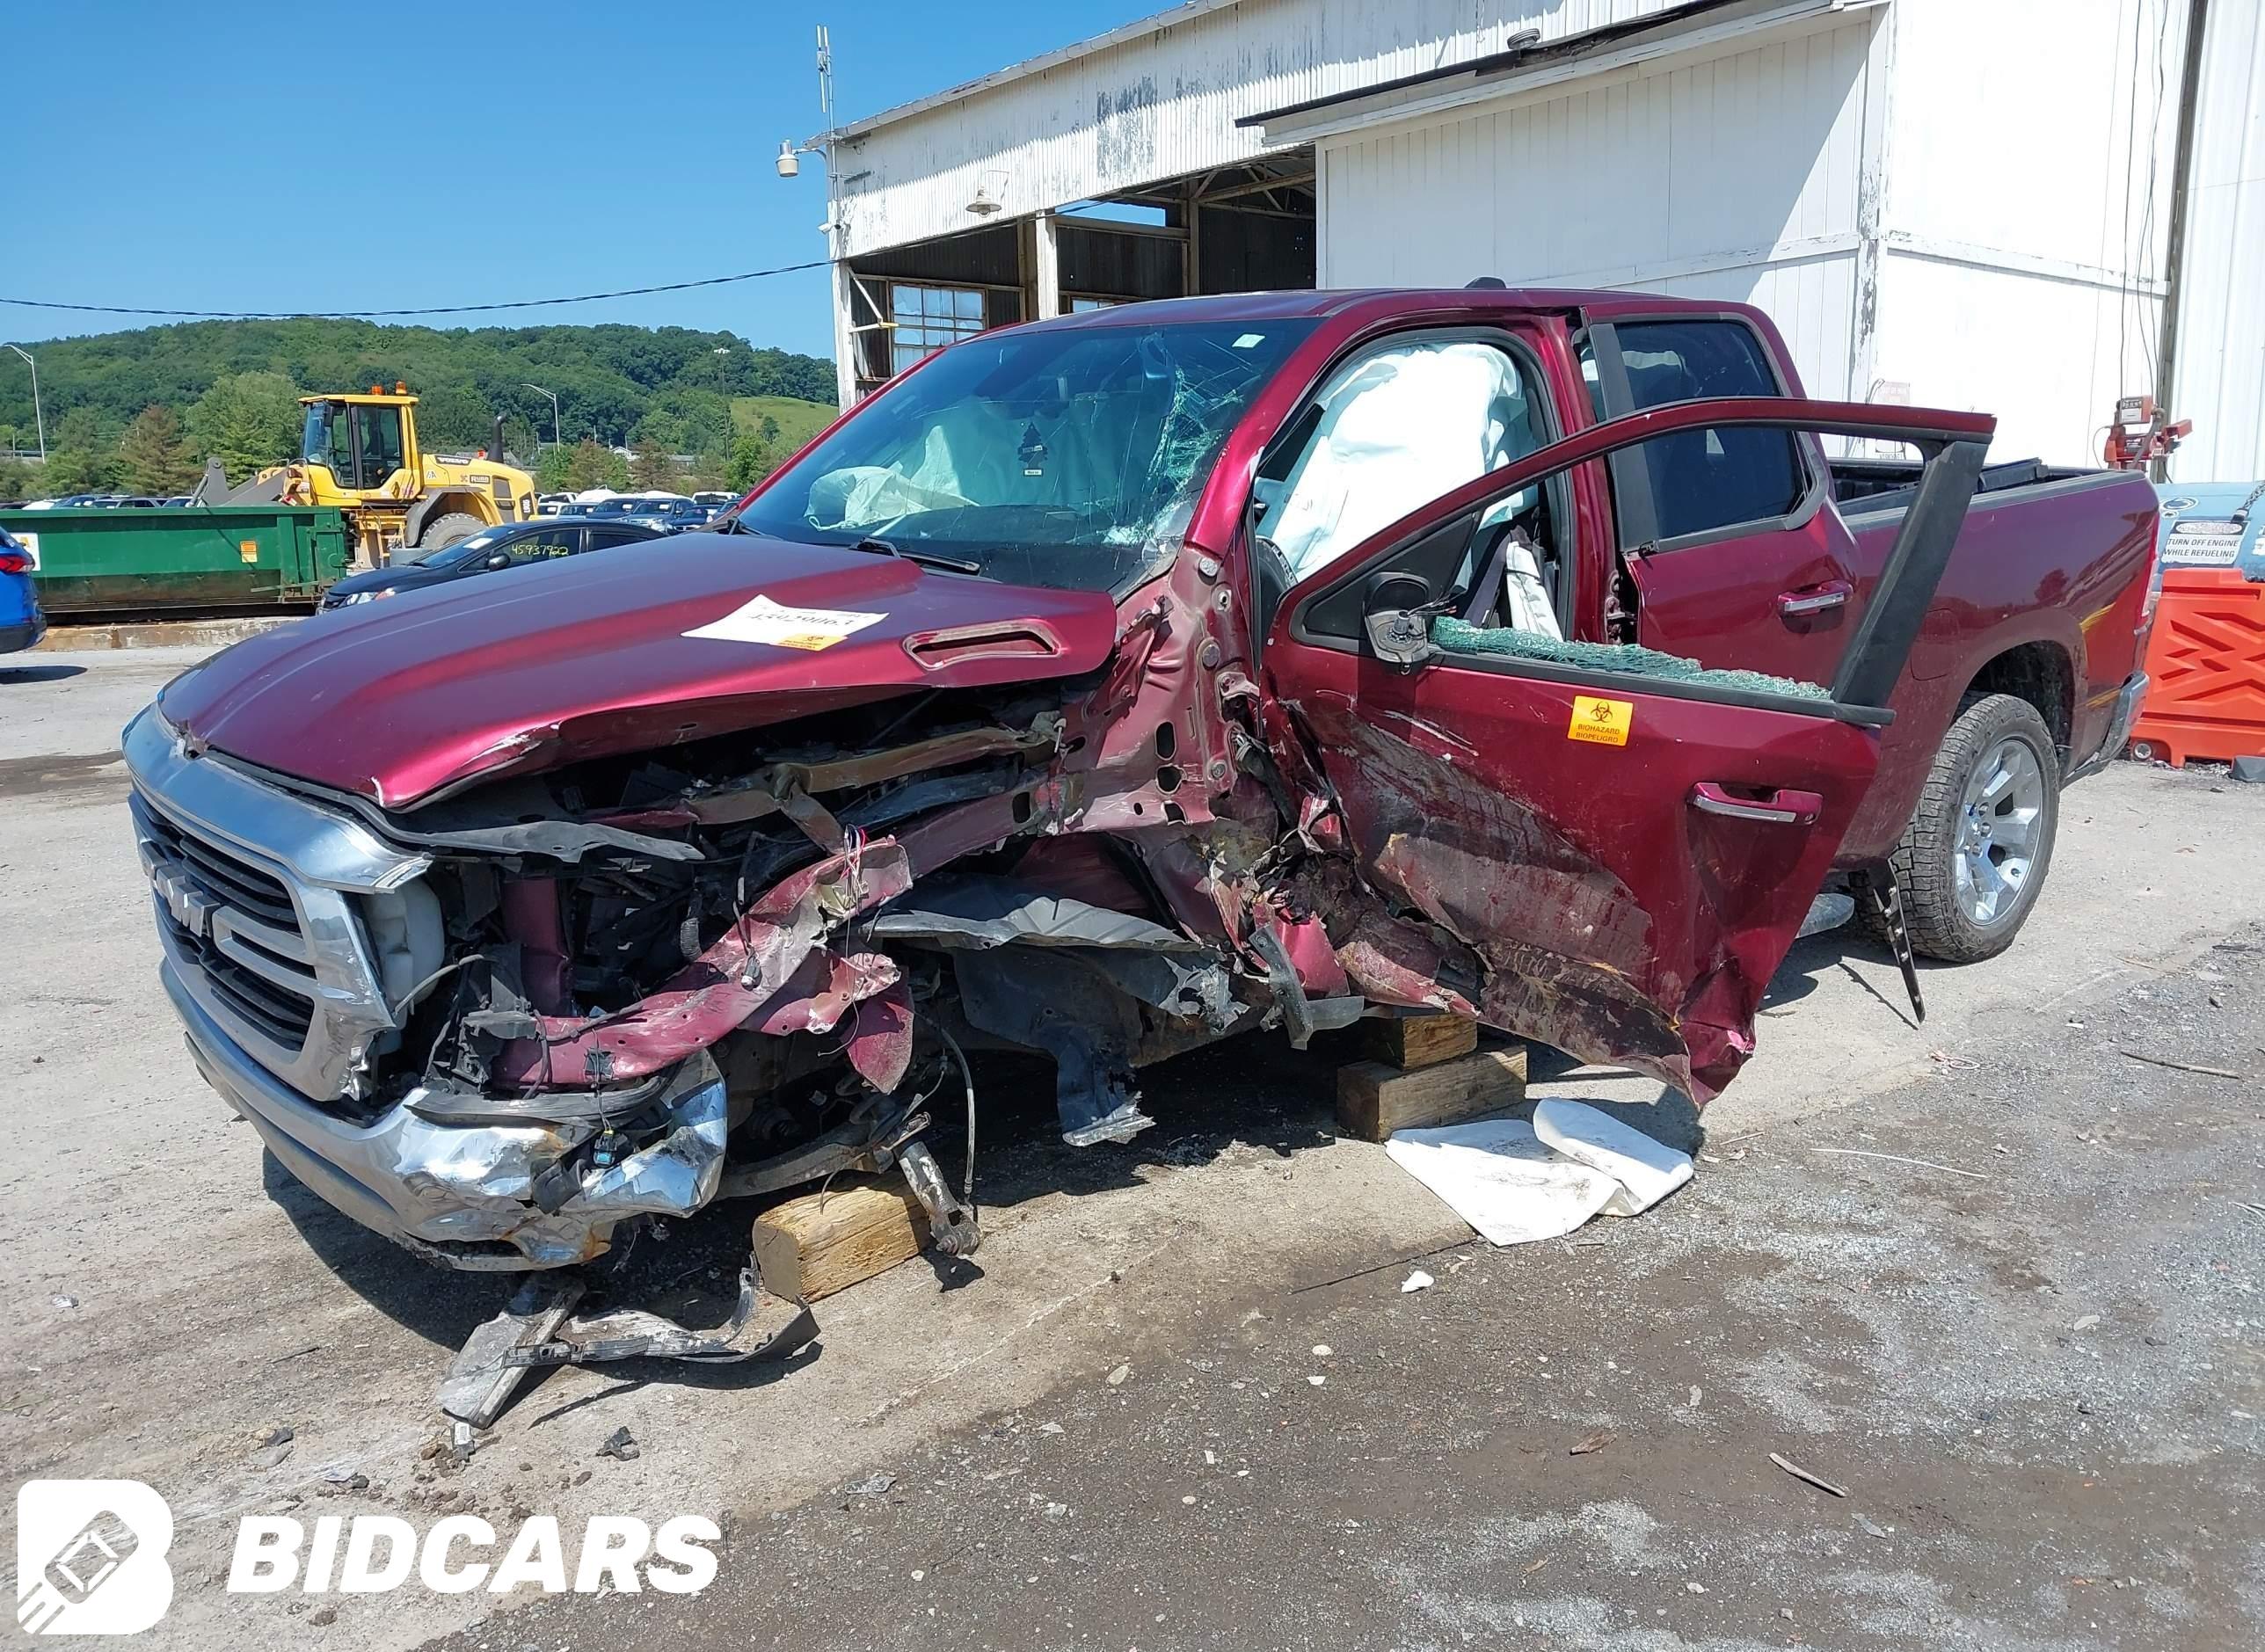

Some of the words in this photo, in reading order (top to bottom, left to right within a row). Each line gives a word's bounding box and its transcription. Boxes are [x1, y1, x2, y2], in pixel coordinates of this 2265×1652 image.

[512, 544, 569, 556] 45937922
[1577, 724, 1620, 734] BIOHAZARD
[1576, 731, 1619, 743] BIOPELIGRO
